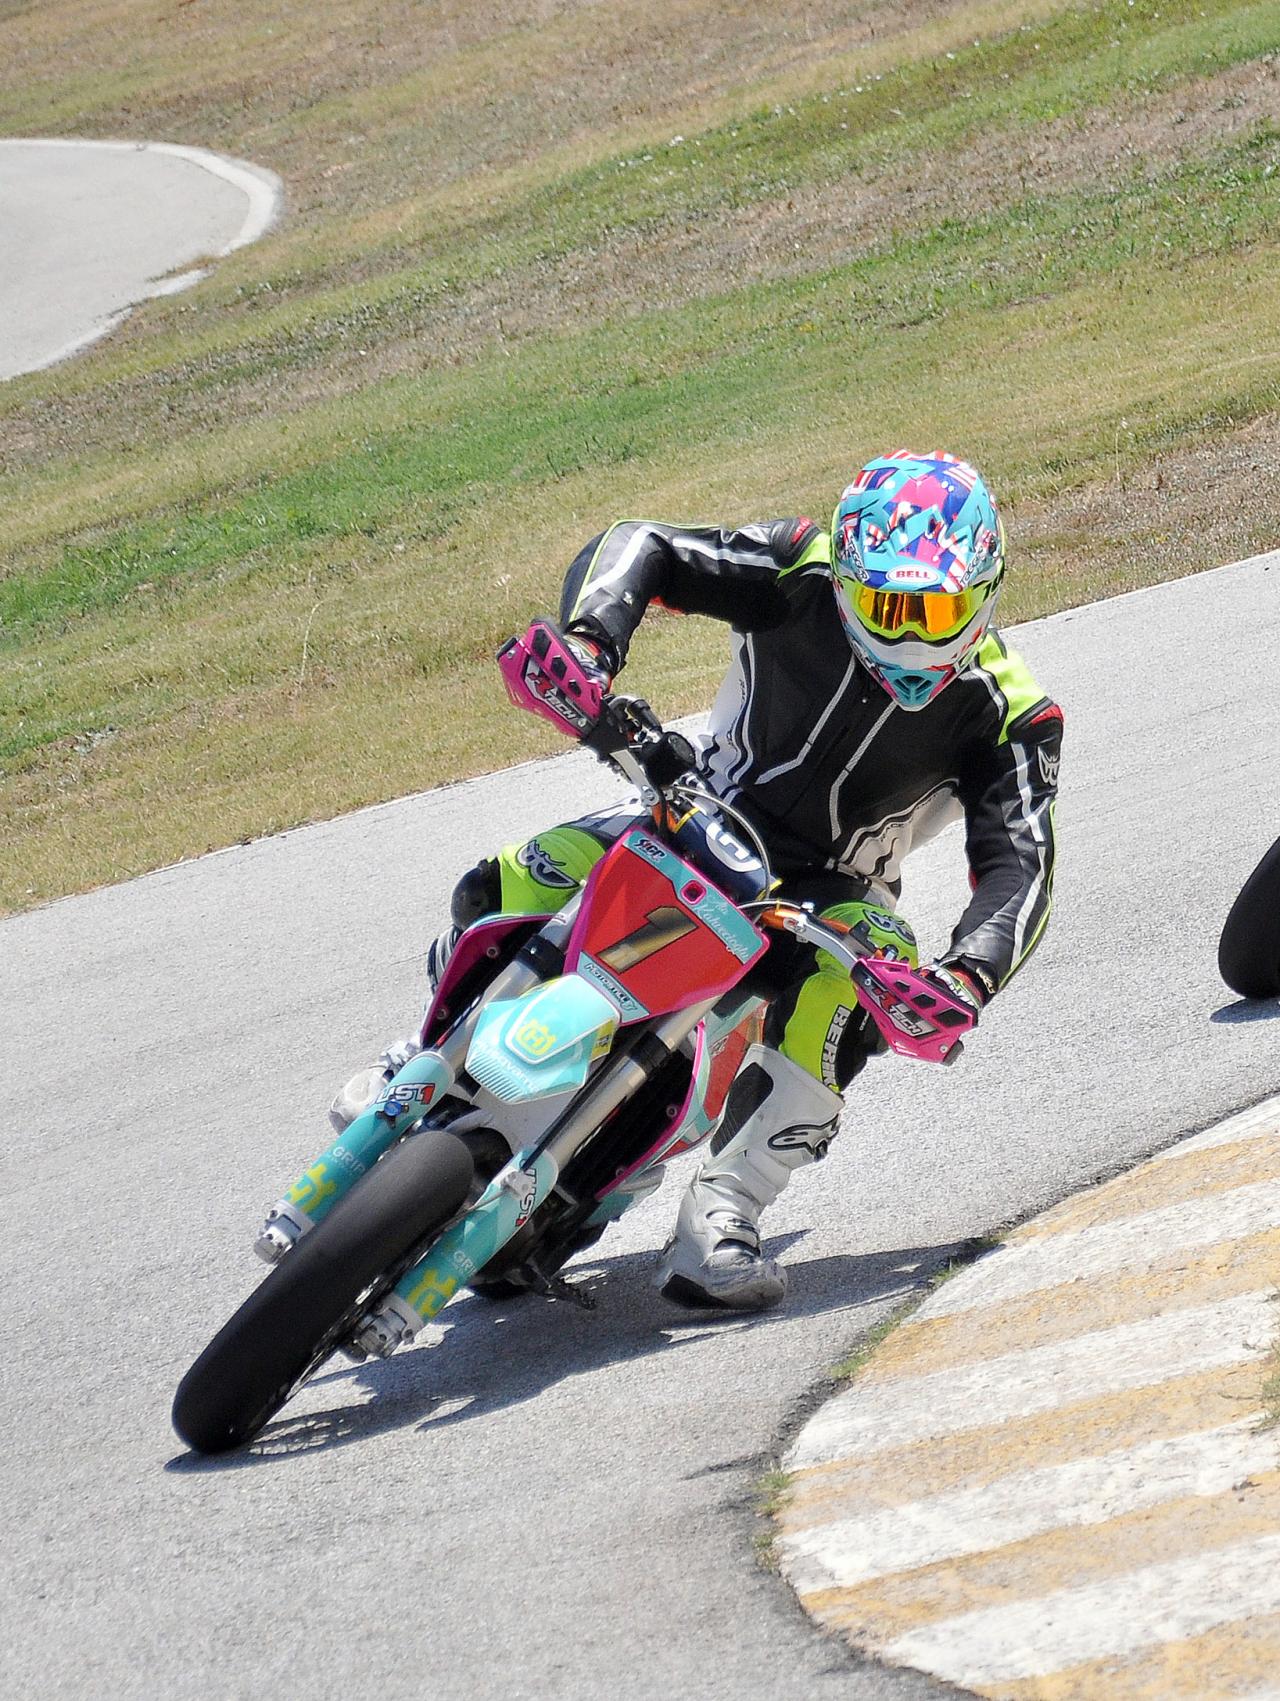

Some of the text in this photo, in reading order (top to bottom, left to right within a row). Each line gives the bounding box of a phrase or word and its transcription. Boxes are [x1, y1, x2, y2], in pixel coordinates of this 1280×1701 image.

[895, 570, 931, 580] BELL
[594, 906, 699, 975] 1
[822, 1005, 852, 1086] BERIK
[376, 1083, 436, 1105] UST1
